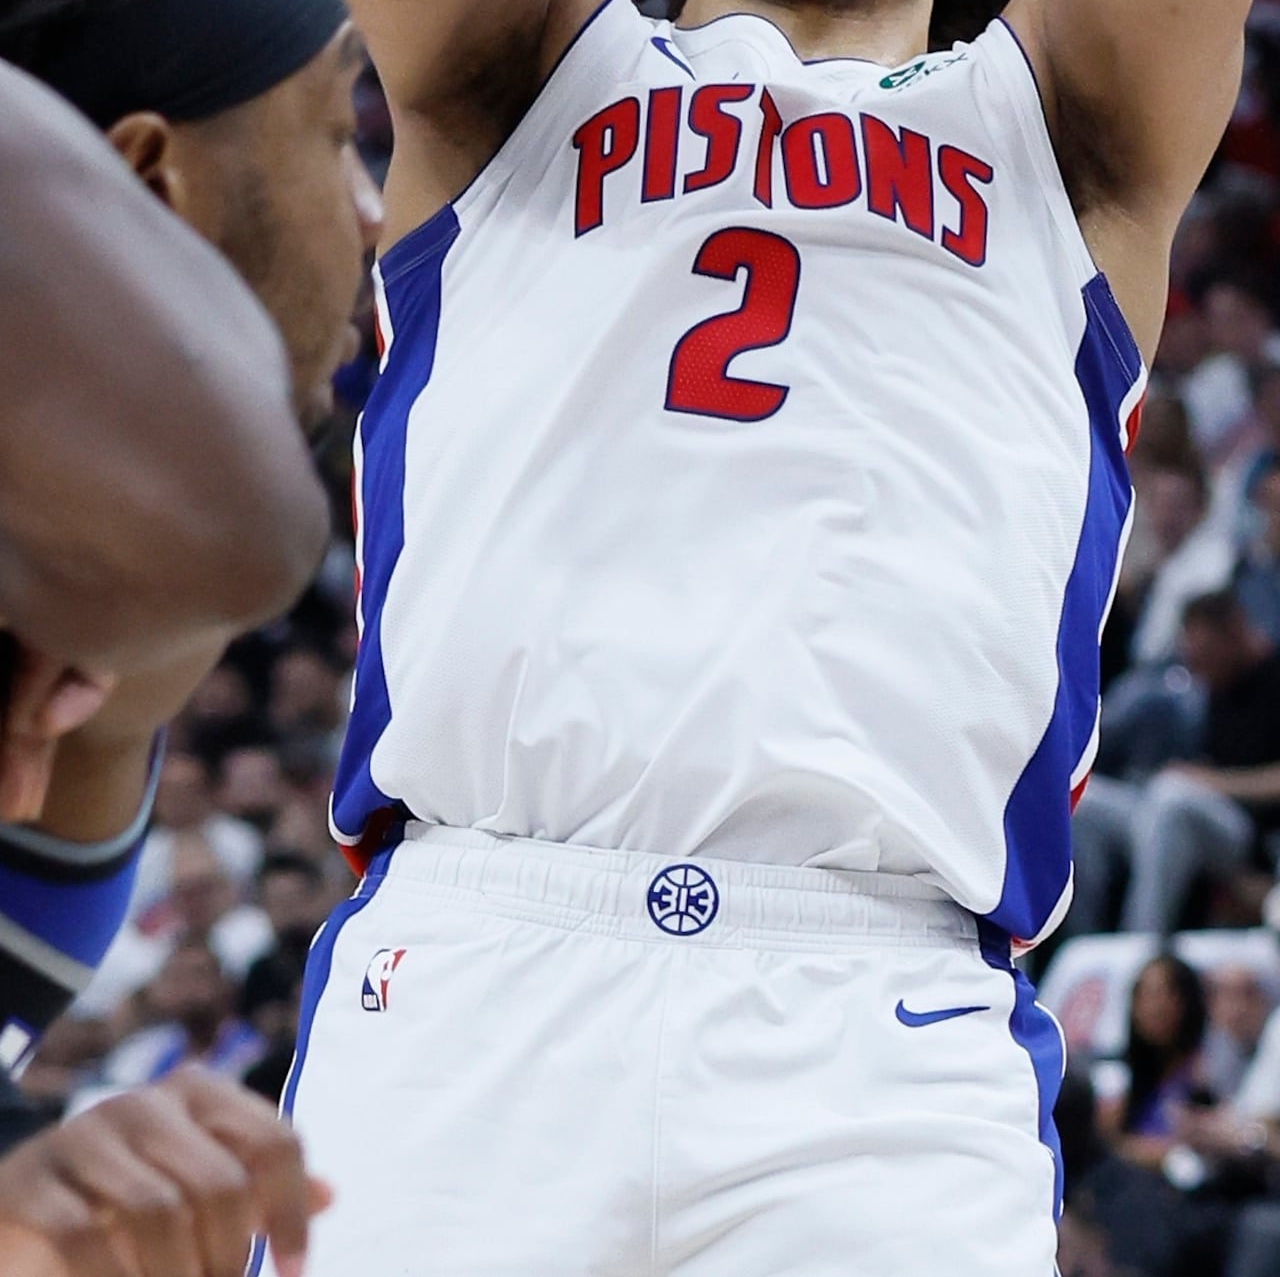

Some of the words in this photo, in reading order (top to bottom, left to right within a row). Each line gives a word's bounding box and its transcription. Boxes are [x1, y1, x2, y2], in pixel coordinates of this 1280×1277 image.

[573, 83, 994, 267] PISTONS
[664, 226, 801, 422] 2
[651, 876, 716, 925] 313
